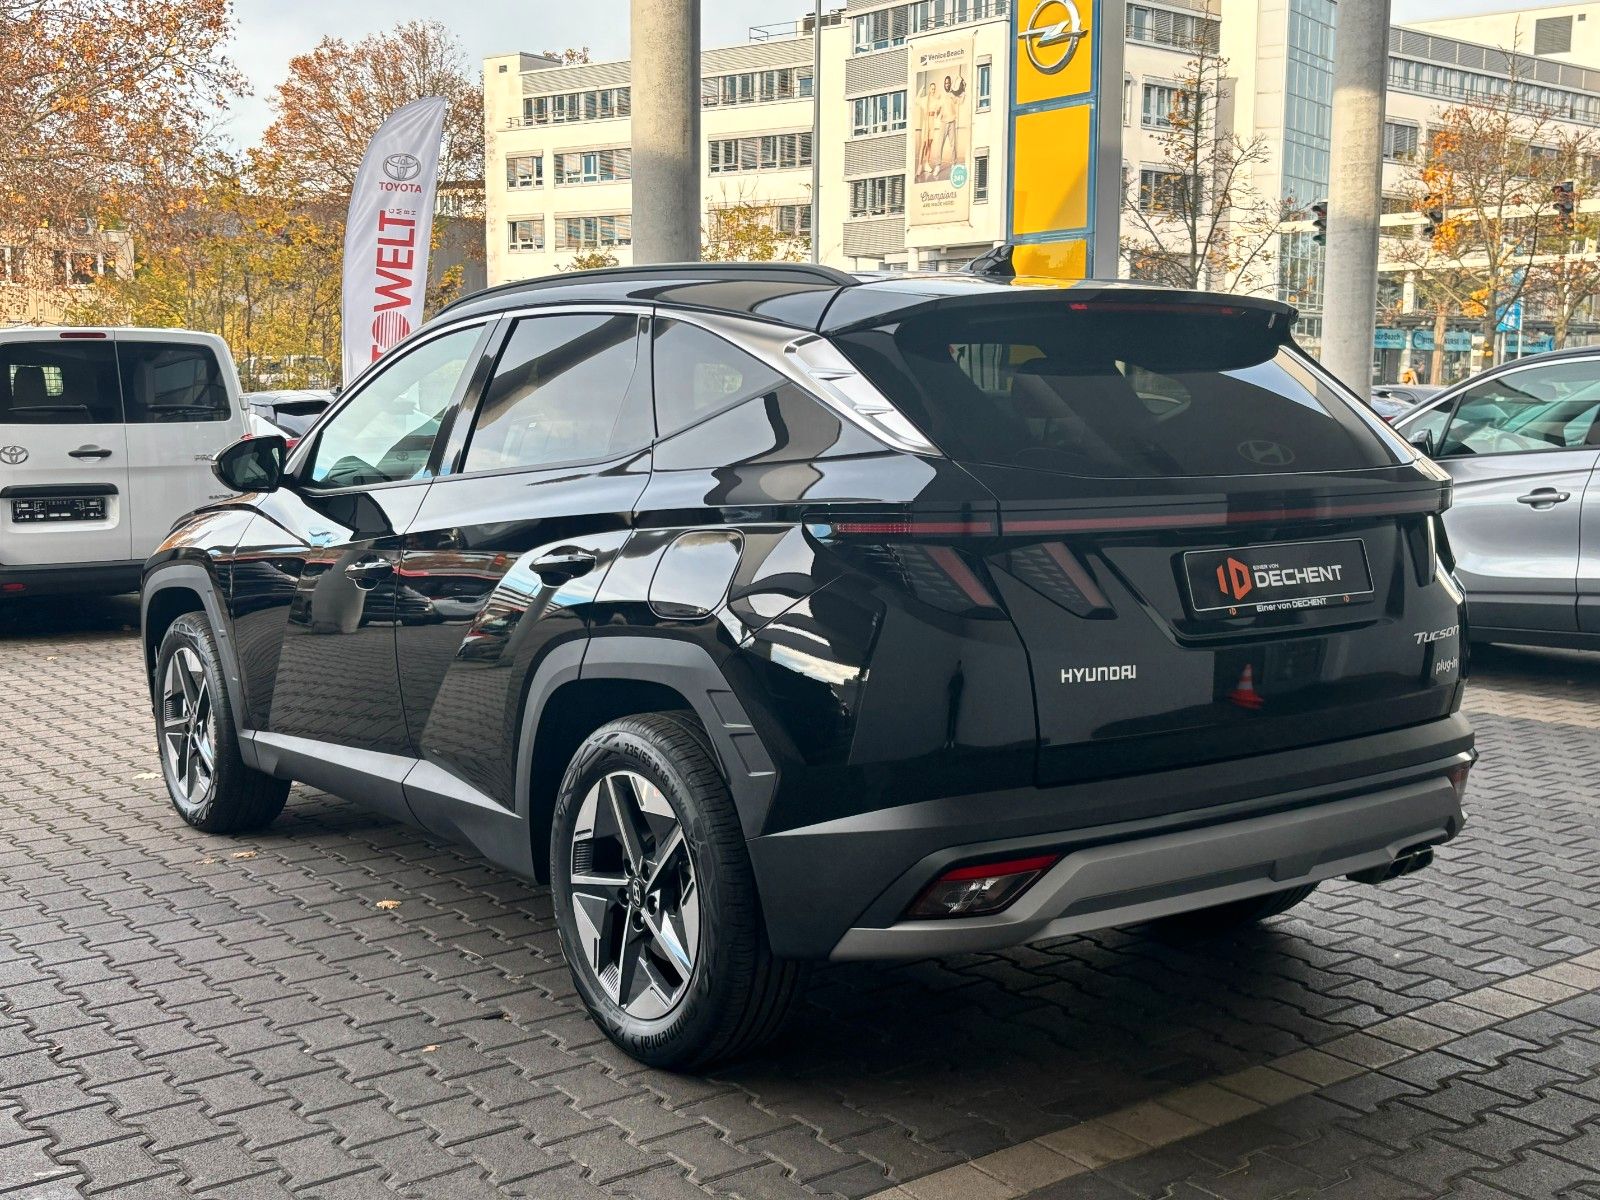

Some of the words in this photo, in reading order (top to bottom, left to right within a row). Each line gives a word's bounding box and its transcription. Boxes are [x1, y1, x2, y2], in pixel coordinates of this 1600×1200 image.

[379, 182, 422, 193] TOYOTA
[920, 190, 957, 202] Champions
[1254, 565, 1342, 588] DECHENT
[1257, 604, 1276, 612] Einer
[1292, 598, 1327, 608] DECHENT
[1061, 665, 1137, 683] HYUNDAI
[1435, 656, 1458, 675] plug-in
[624, 743, 653, 767] 235/55
